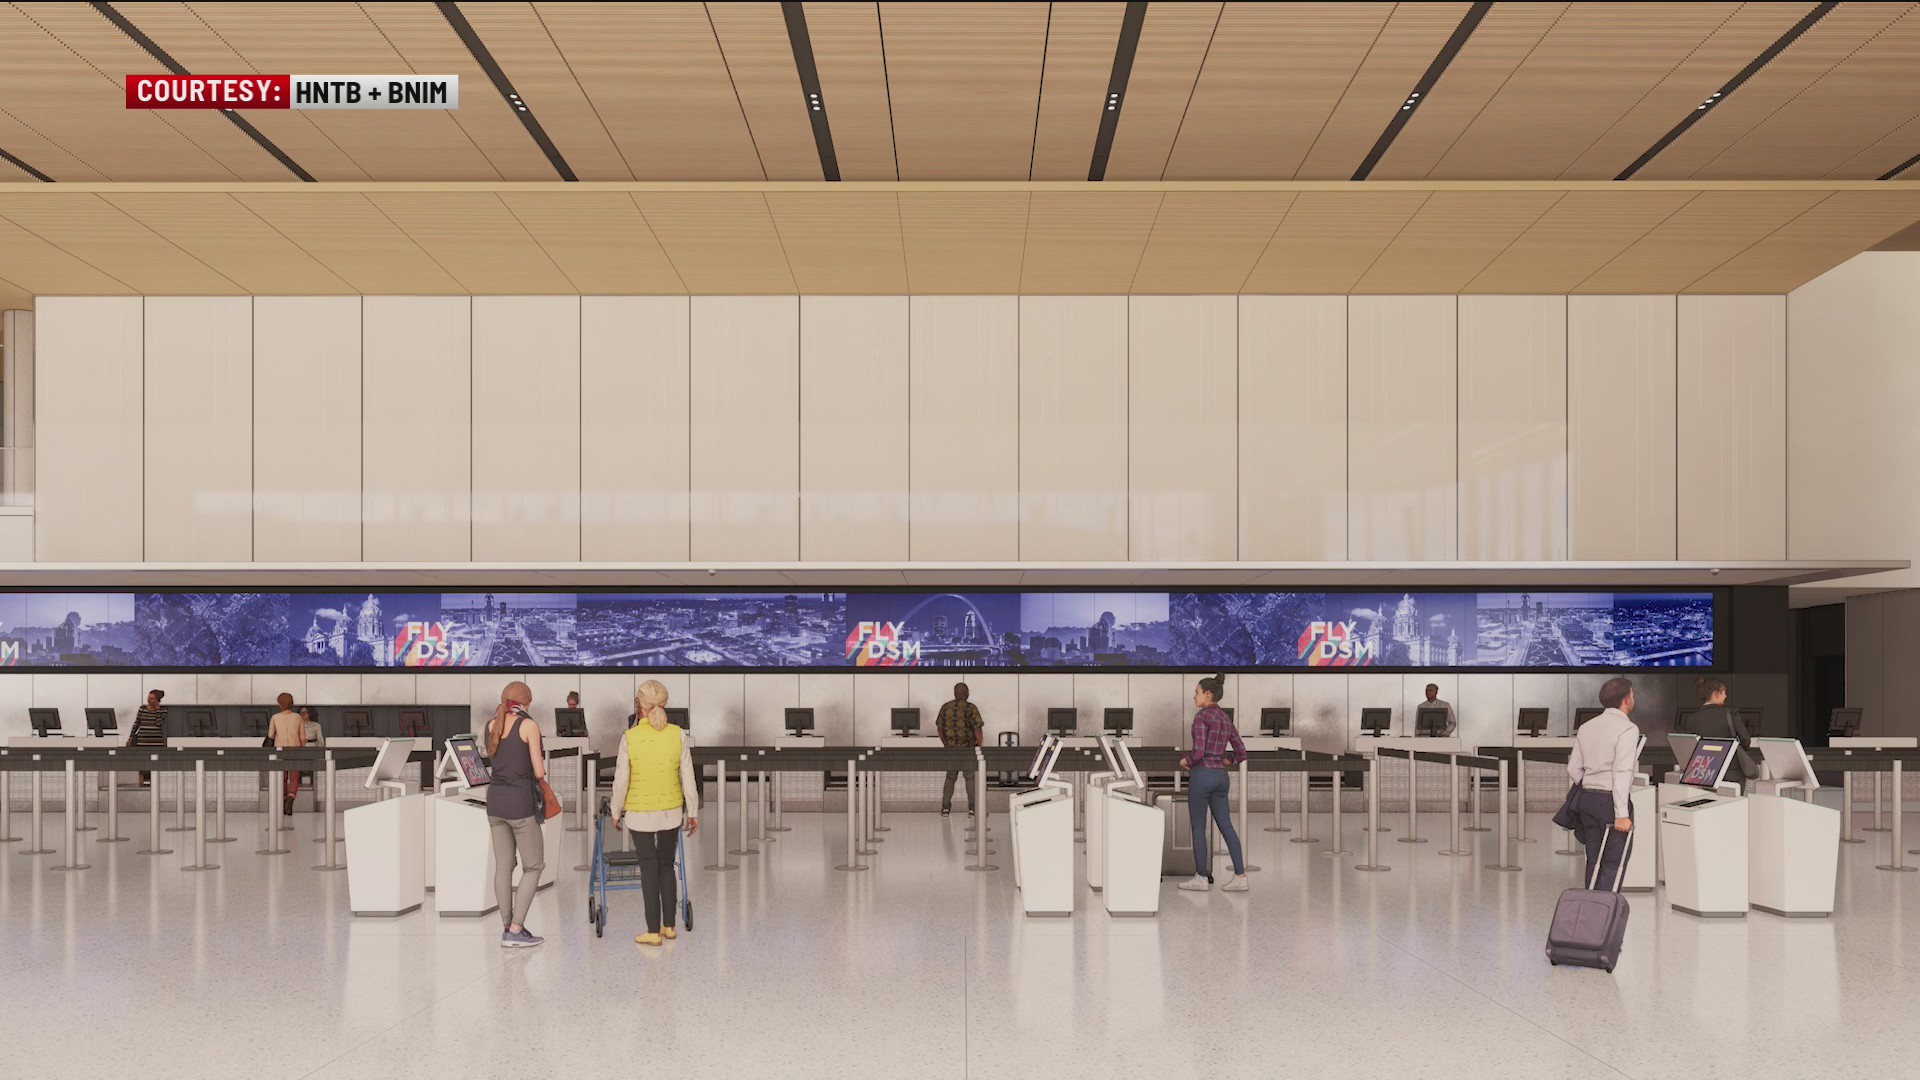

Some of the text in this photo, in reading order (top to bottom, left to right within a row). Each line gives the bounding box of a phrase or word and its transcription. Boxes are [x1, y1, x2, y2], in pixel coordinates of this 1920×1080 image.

[407, 621, 455, 641] FLY
[858, 621, 905, 641] FLY
[1310, 621, 1357, 641] FLY
[417, 640, 470, 659] DSM
[868, 640, 921, 659] DSM
[1320, 640, 1373, 659] DSM
[461, 756, 477, 768] FLY
[1692, 755, 1715, 768] FLY
[470, 767, 487, 778] DSM
[1692, 767, 1715, 781] DSM
